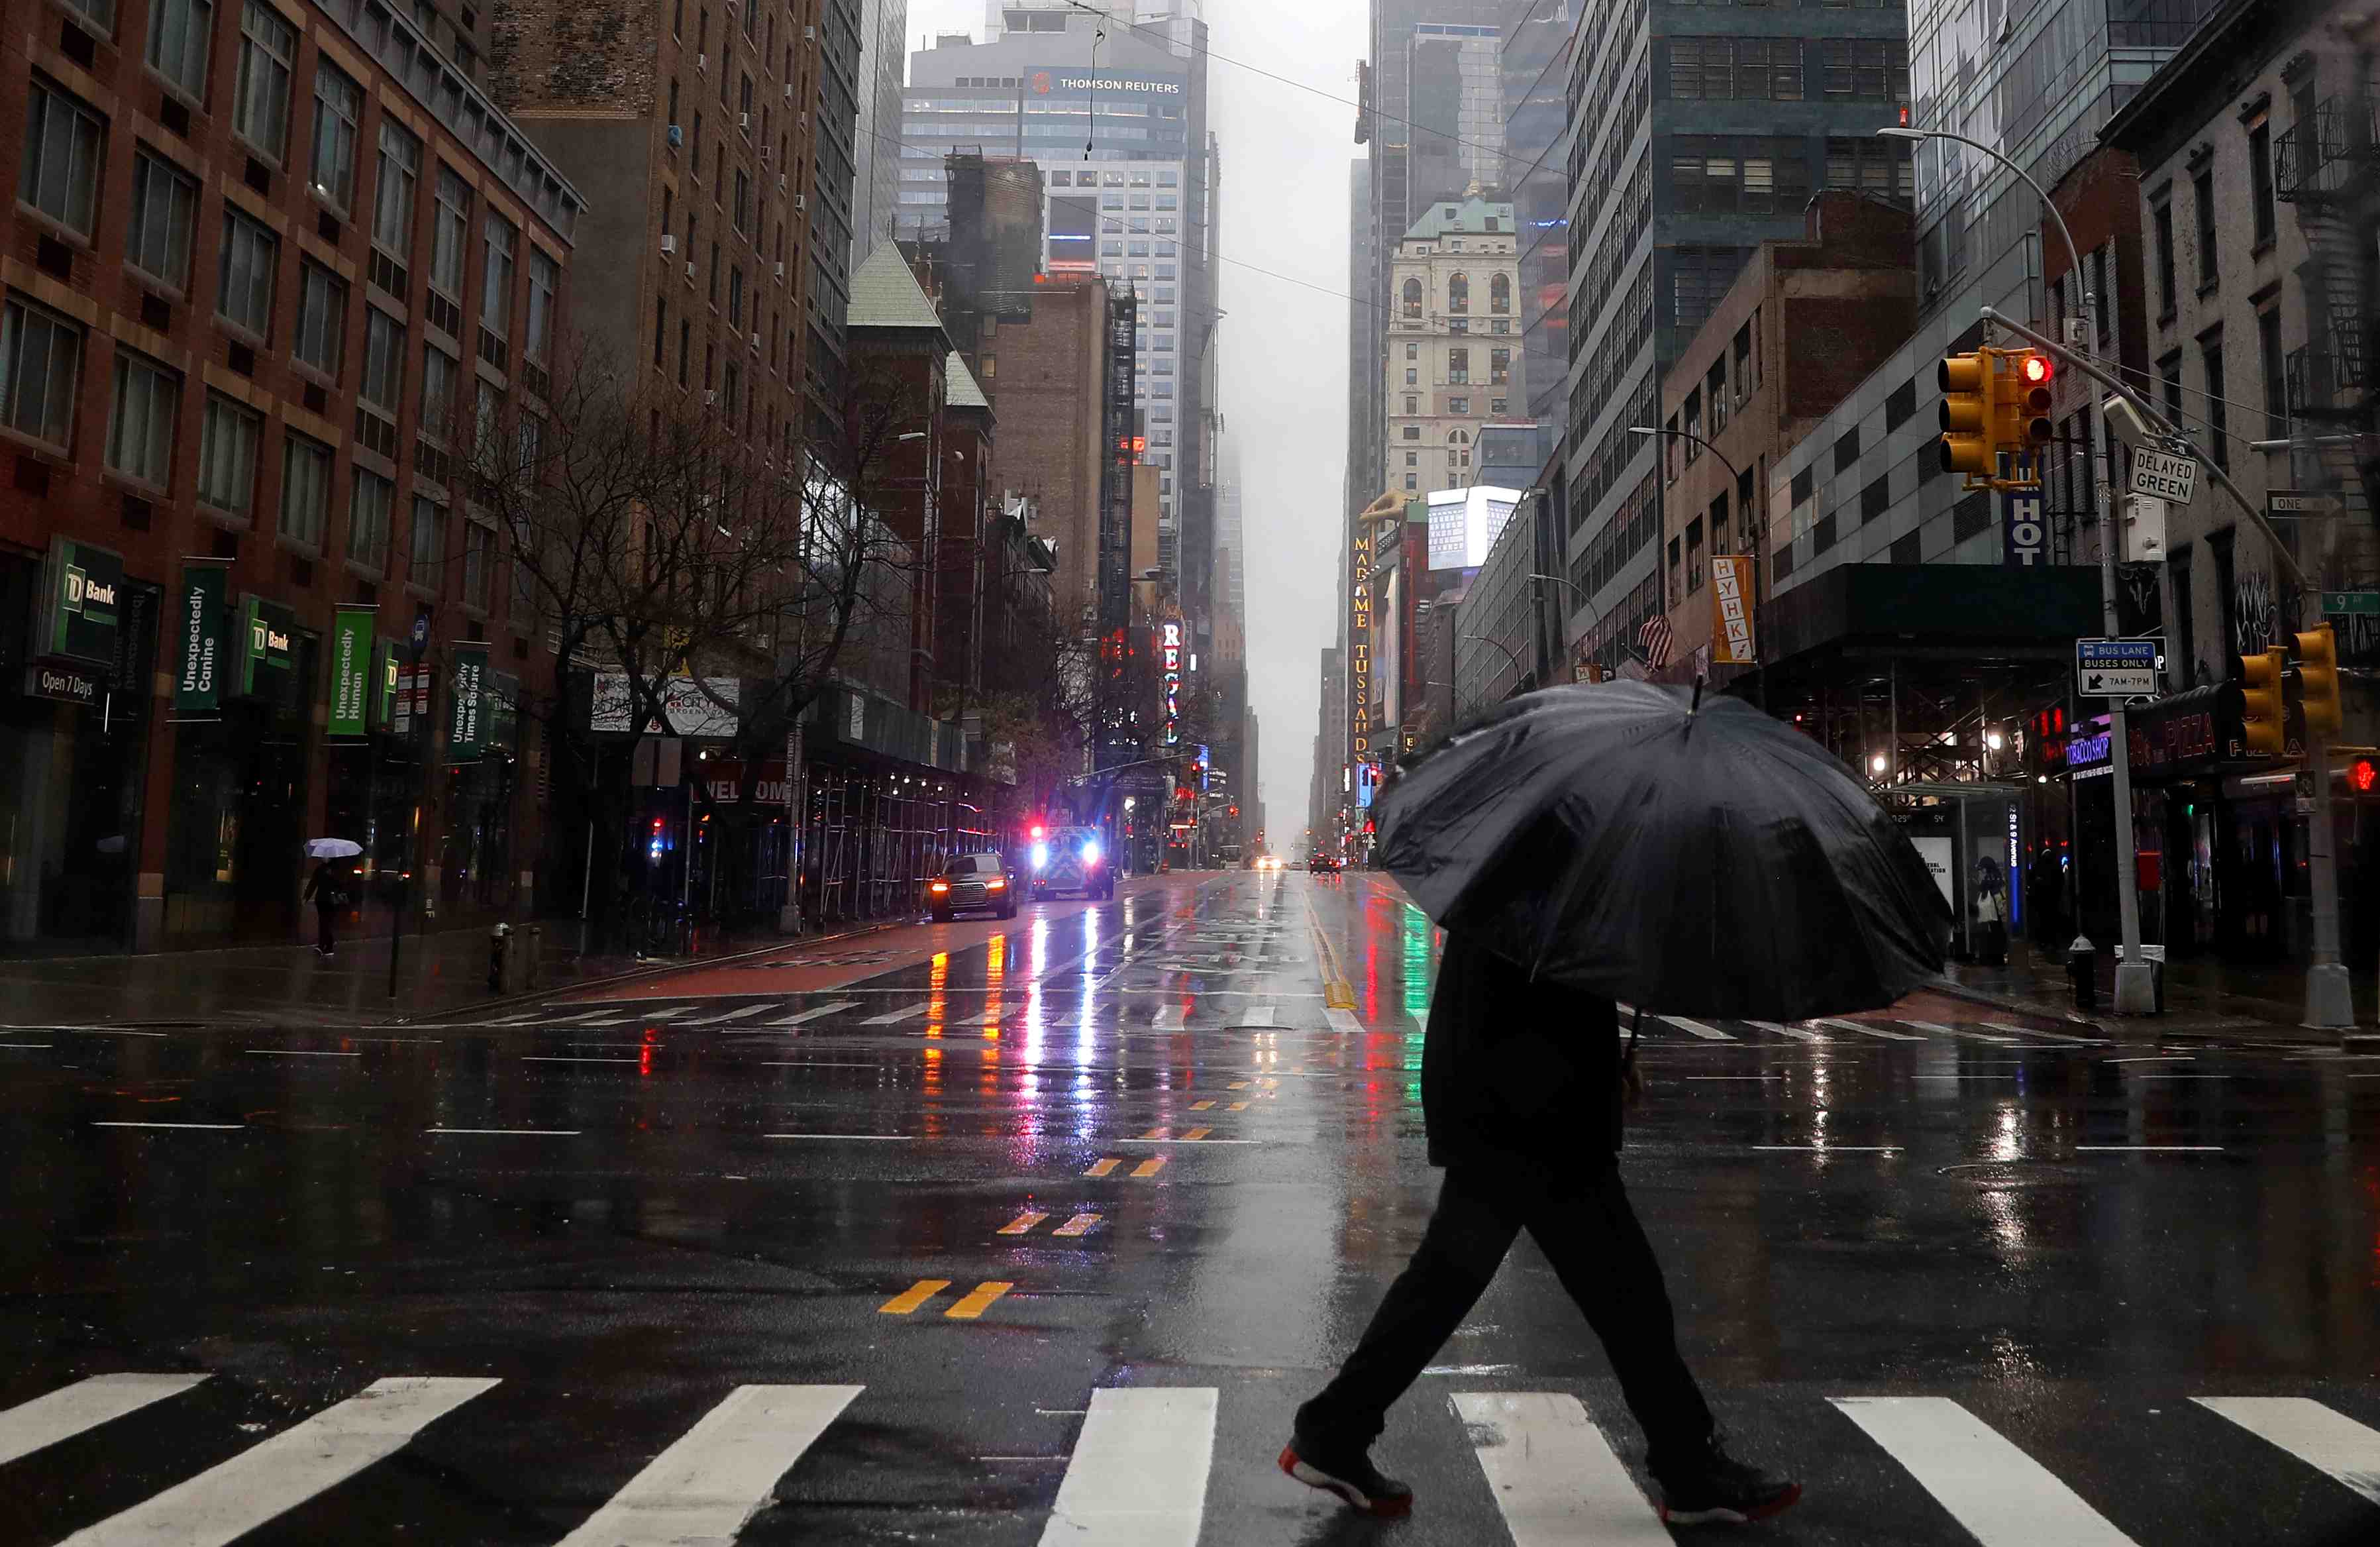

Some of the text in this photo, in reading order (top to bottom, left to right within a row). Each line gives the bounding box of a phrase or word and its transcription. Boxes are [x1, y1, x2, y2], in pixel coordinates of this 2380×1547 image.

[1061, 78, 1179, 94] THOMSON REUTERS
[2138, 453, 2191, 479] DELAYED
[2137, 472, 2189, 498] GREEN
[2278, 498, 2301, 509] ONE
[85, 579, 115, 605] Bank
[1355, 537, 1369, 627] MADAME
[2337, 595, 2346, 610] 9
[182, 586, 206, 692] Unexpectedly
[268, 630, 289, 652] Bank
[2098, 646, 2149, 655] BUS LANE
[199, 637, 215, 692] Canine
[335, 629, 354, 720] Unexpectedly
[2085, 659, 2149, 668] BUSES ONLY
[42, 670, 93, 699] Open 7 Days
[2109, 677, 2149, 686] 7AM-7PM
[349, 672, 362, 720] Human
[453, 663, 470, 743] Unexpeedly
[464, 709, 476, 743] Times
[2066, 737, 2108, 766] TOBACCO SHOP
[705, 779, 788, 800] WELOM
